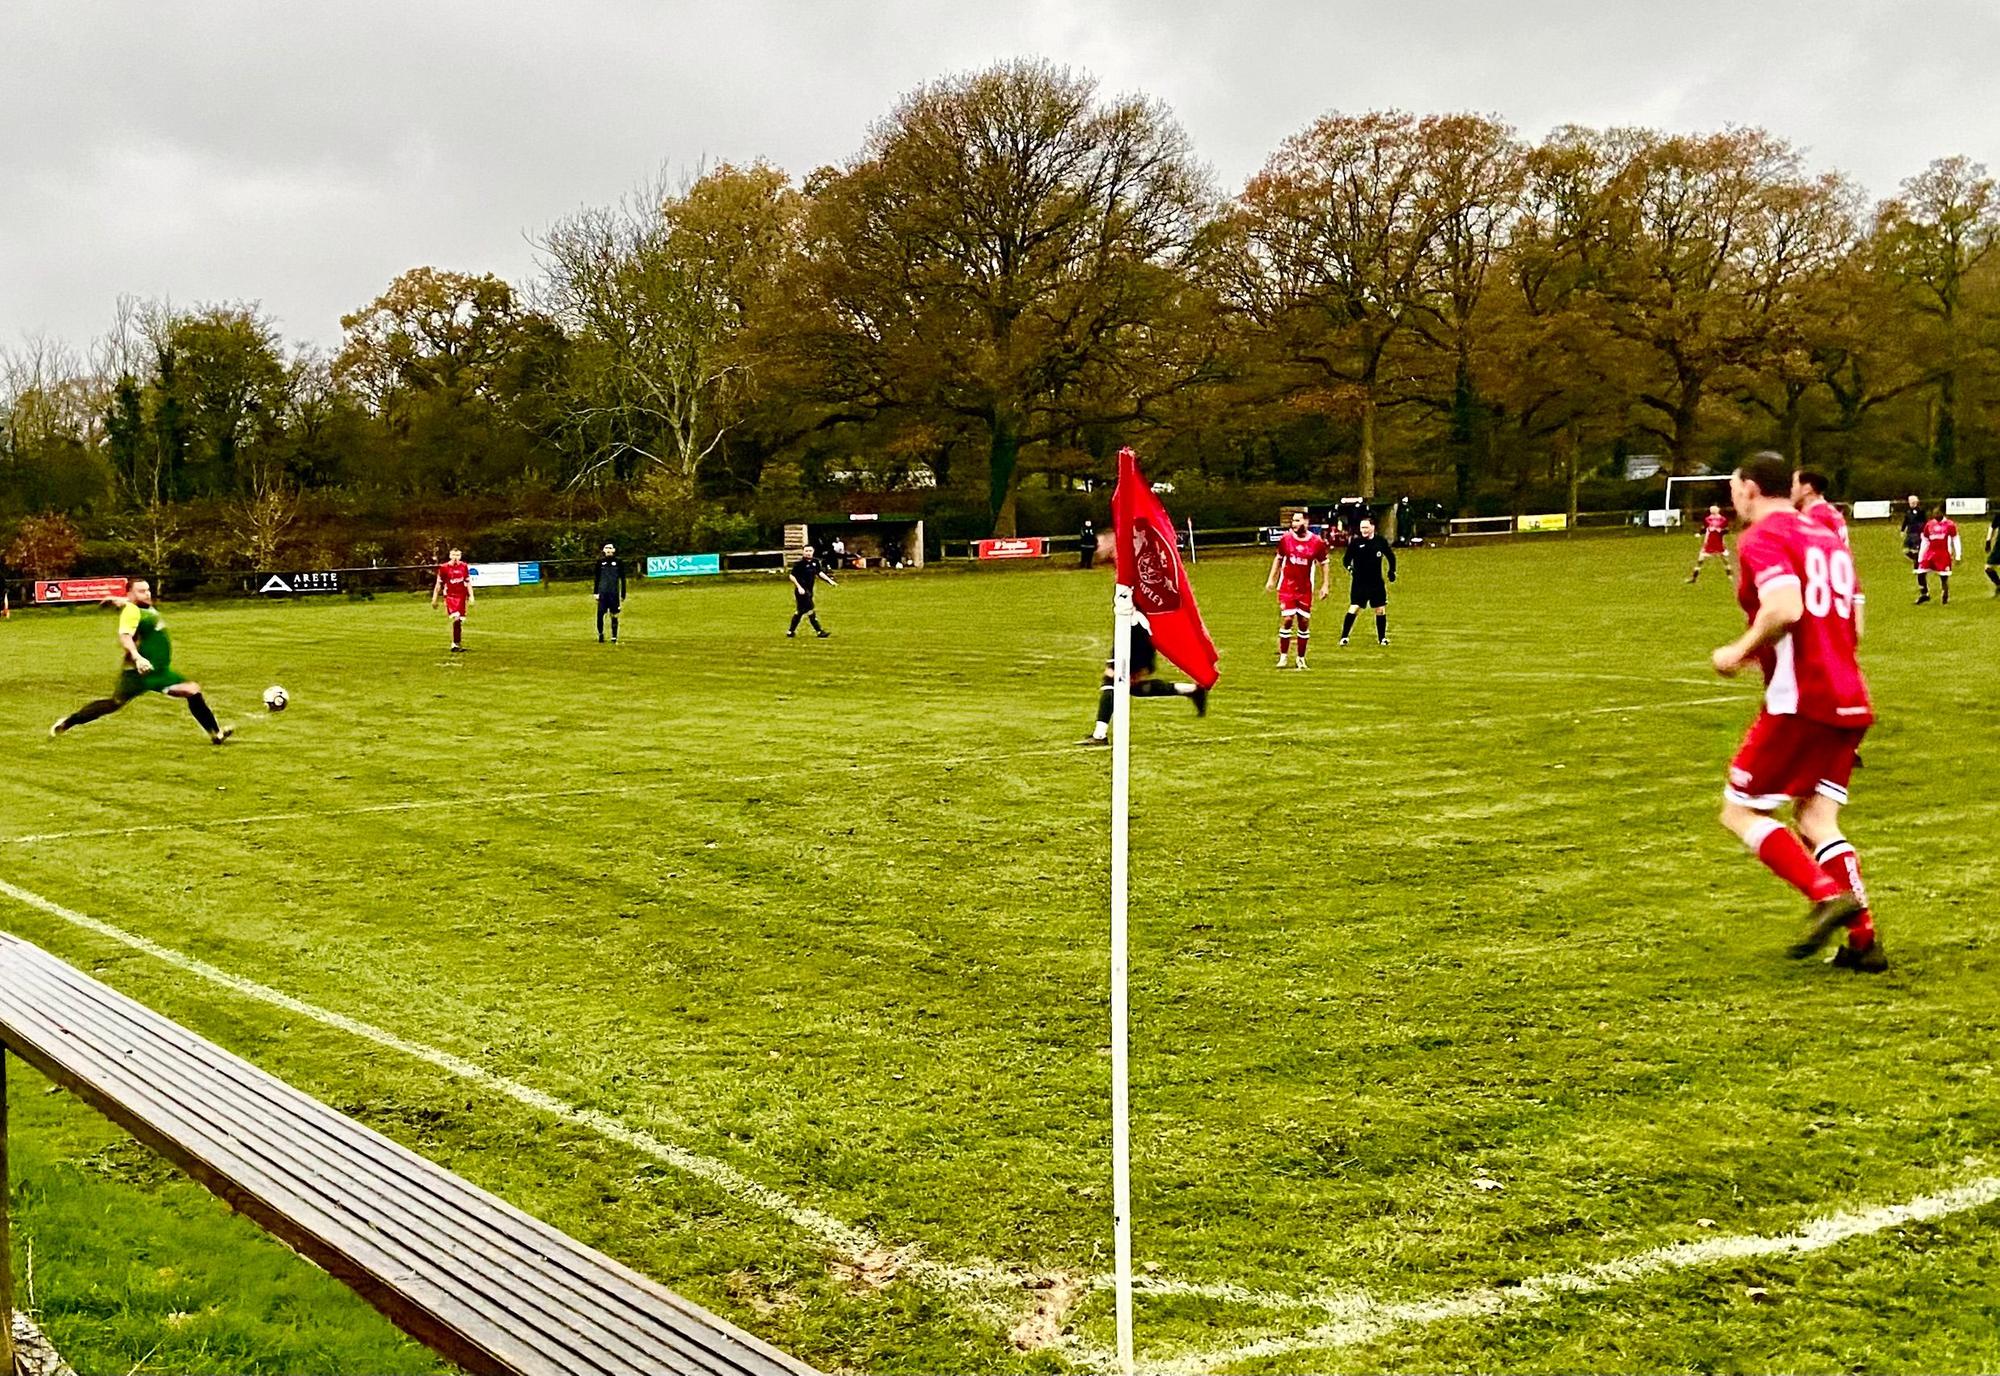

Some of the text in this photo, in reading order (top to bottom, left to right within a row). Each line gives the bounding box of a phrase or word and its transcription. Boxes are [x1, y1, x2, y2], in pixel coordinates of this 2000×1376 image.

[649, 558, 678, 572] SMS
[293, 573, 338, 583] ARETE
[1804, 546, 1854, 620] 89
